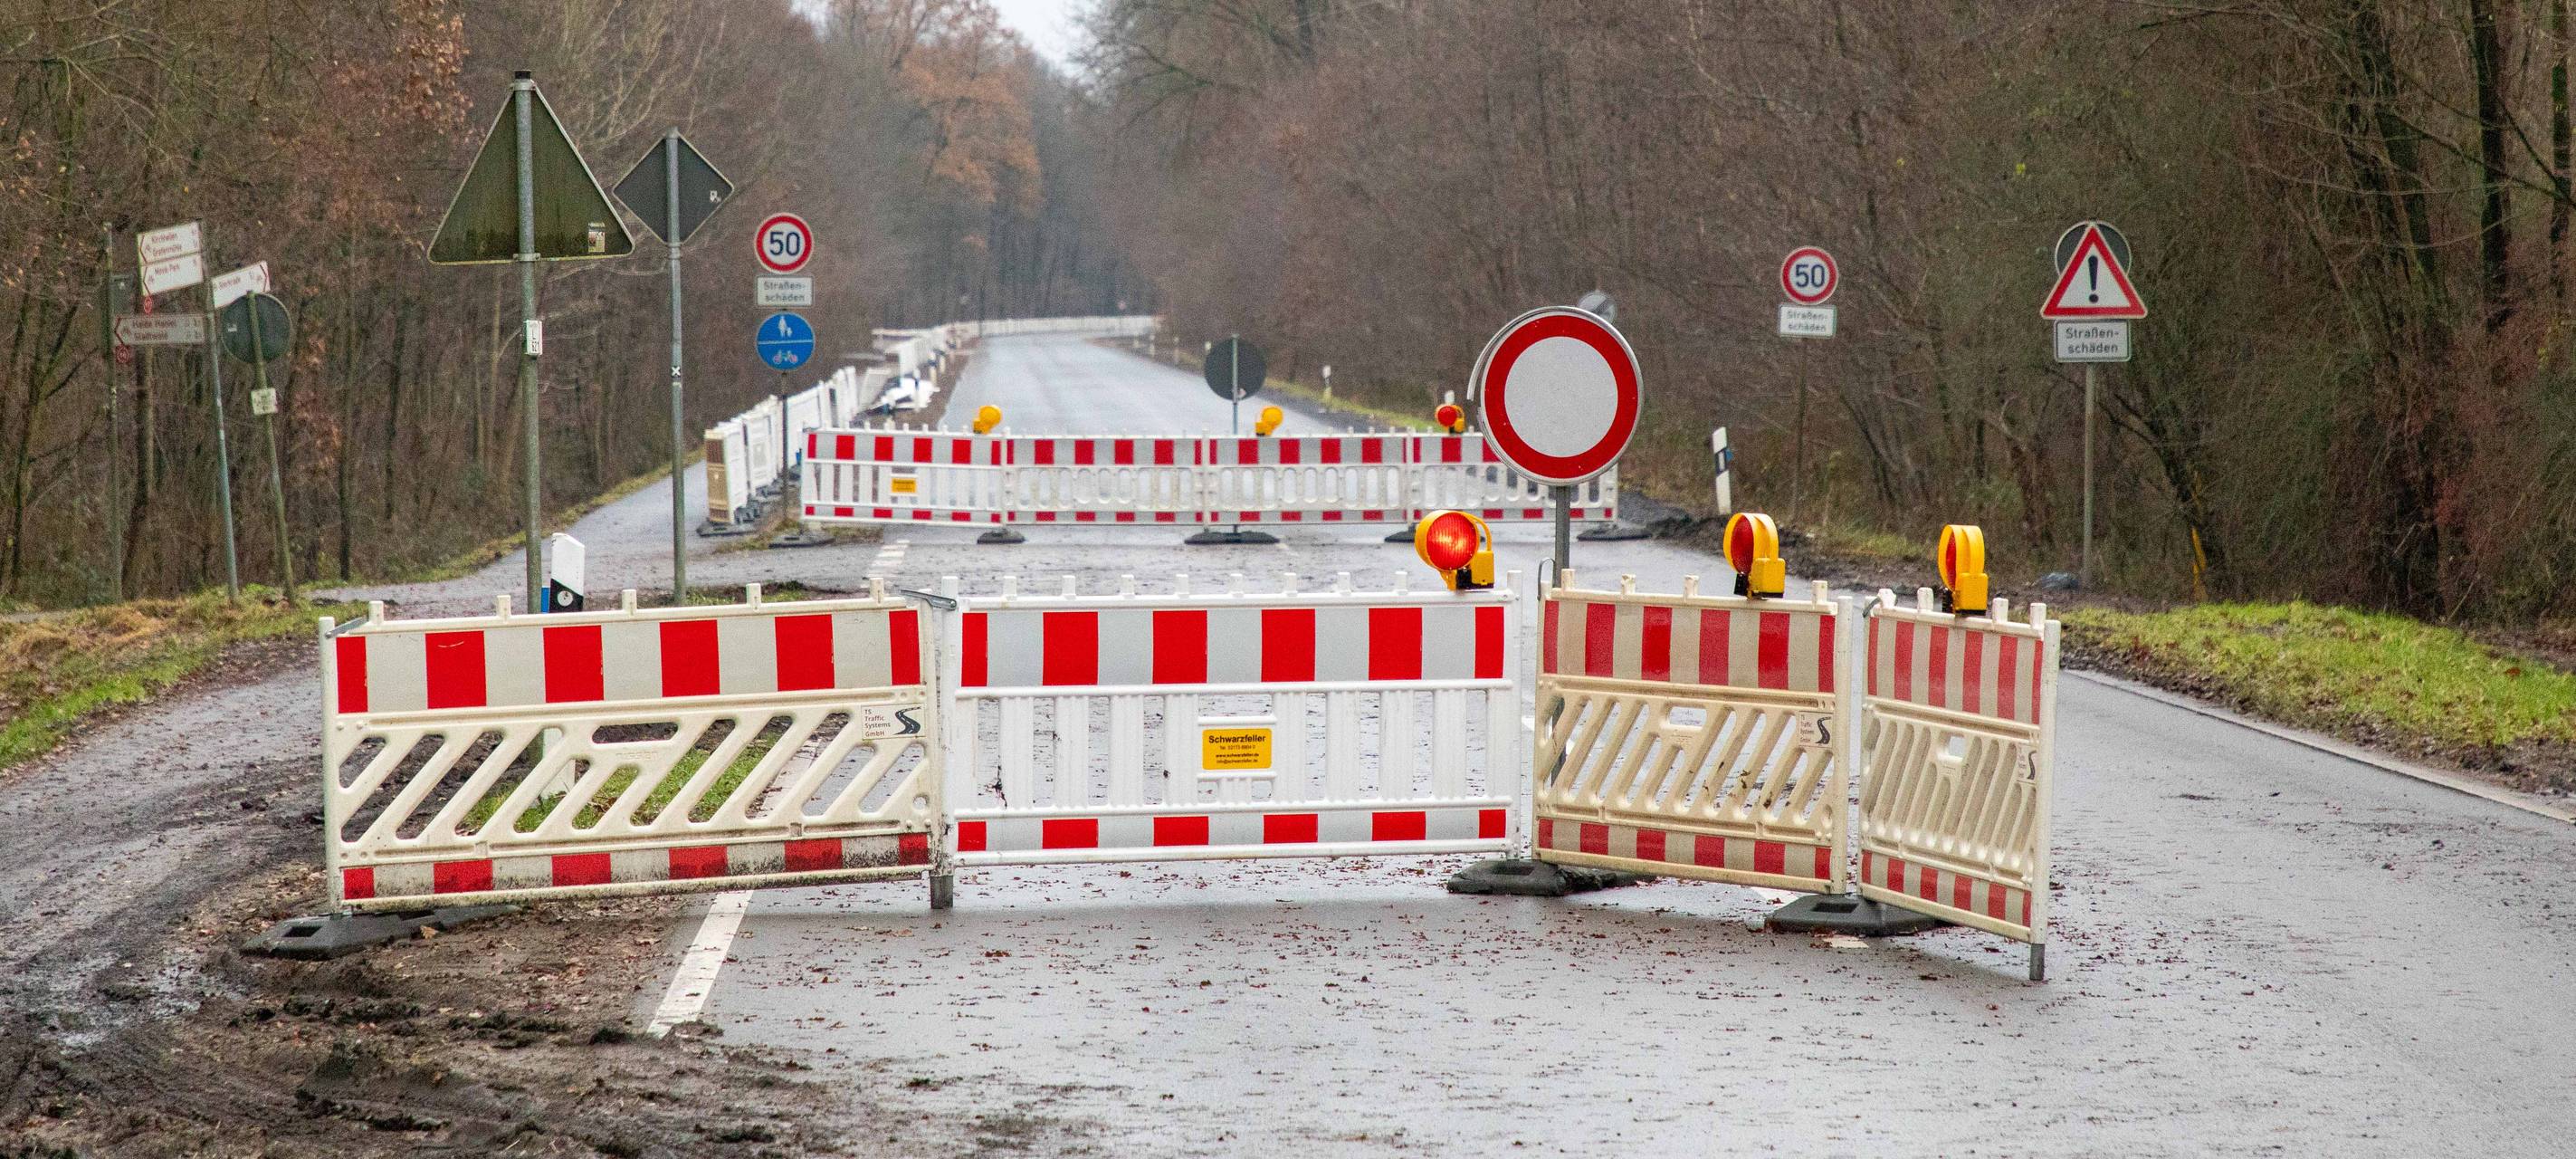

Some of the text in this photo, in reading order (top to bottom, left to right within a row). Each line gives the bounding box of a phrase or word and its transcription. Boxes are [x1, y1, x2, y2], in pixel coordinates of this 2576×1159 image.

[770, 232, 800, 256] 50
[1795, 263, 1825, 288] 50
[764, 281, 806, 292] Straßen-
[766, 292, 805, 302] schäden
[2066, 327, 2120, 340] Straßen-
[2067, 342, 2118, 354] schäden
[1208, 734, 1266, 743] Schwarzfeller
